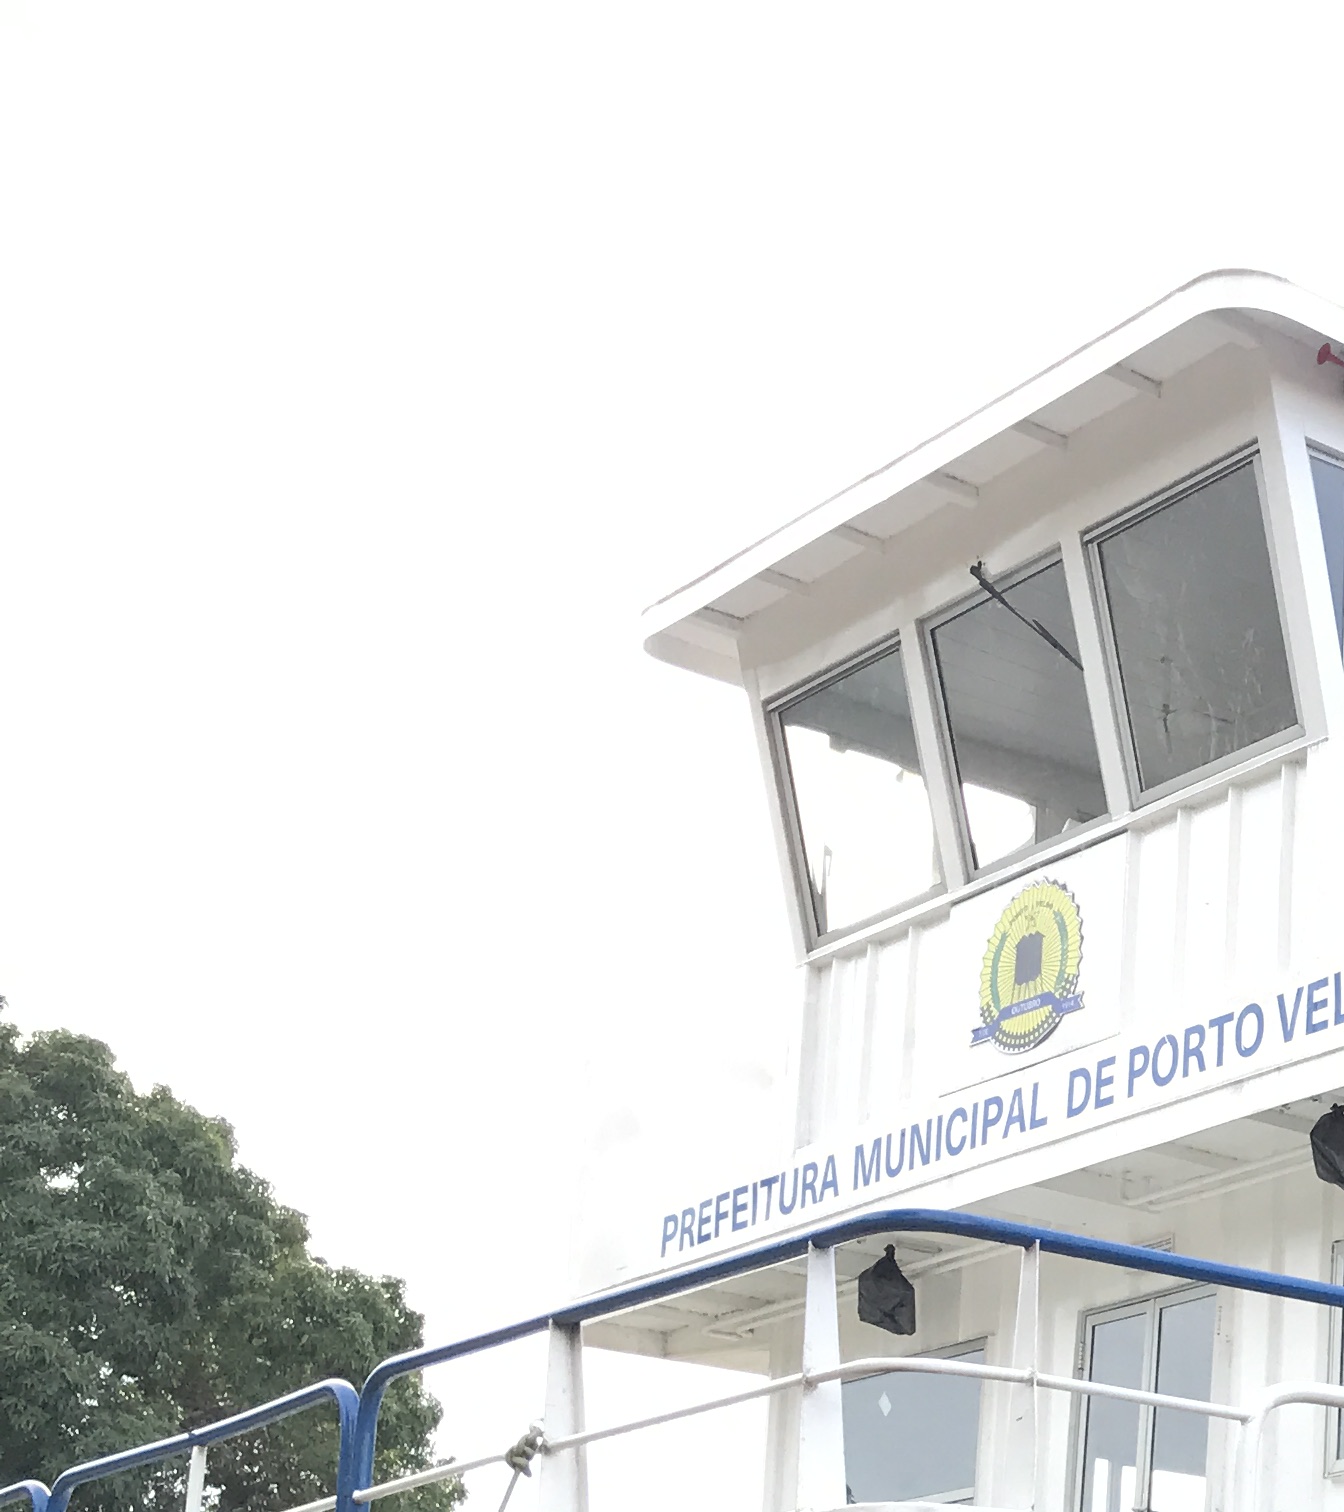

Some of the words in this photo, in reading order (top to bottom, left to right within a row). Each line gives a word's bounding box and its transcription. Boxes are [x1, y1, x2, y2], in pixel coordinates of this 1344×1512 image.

[660, 1155, 839, 1258] PREFEITURA
[854, 1085, 1047, 1188] MUNICIPAL
[1066, 1057, 1116, 1118] DE
[1127, 1003, 1265, 1096] PORTO
